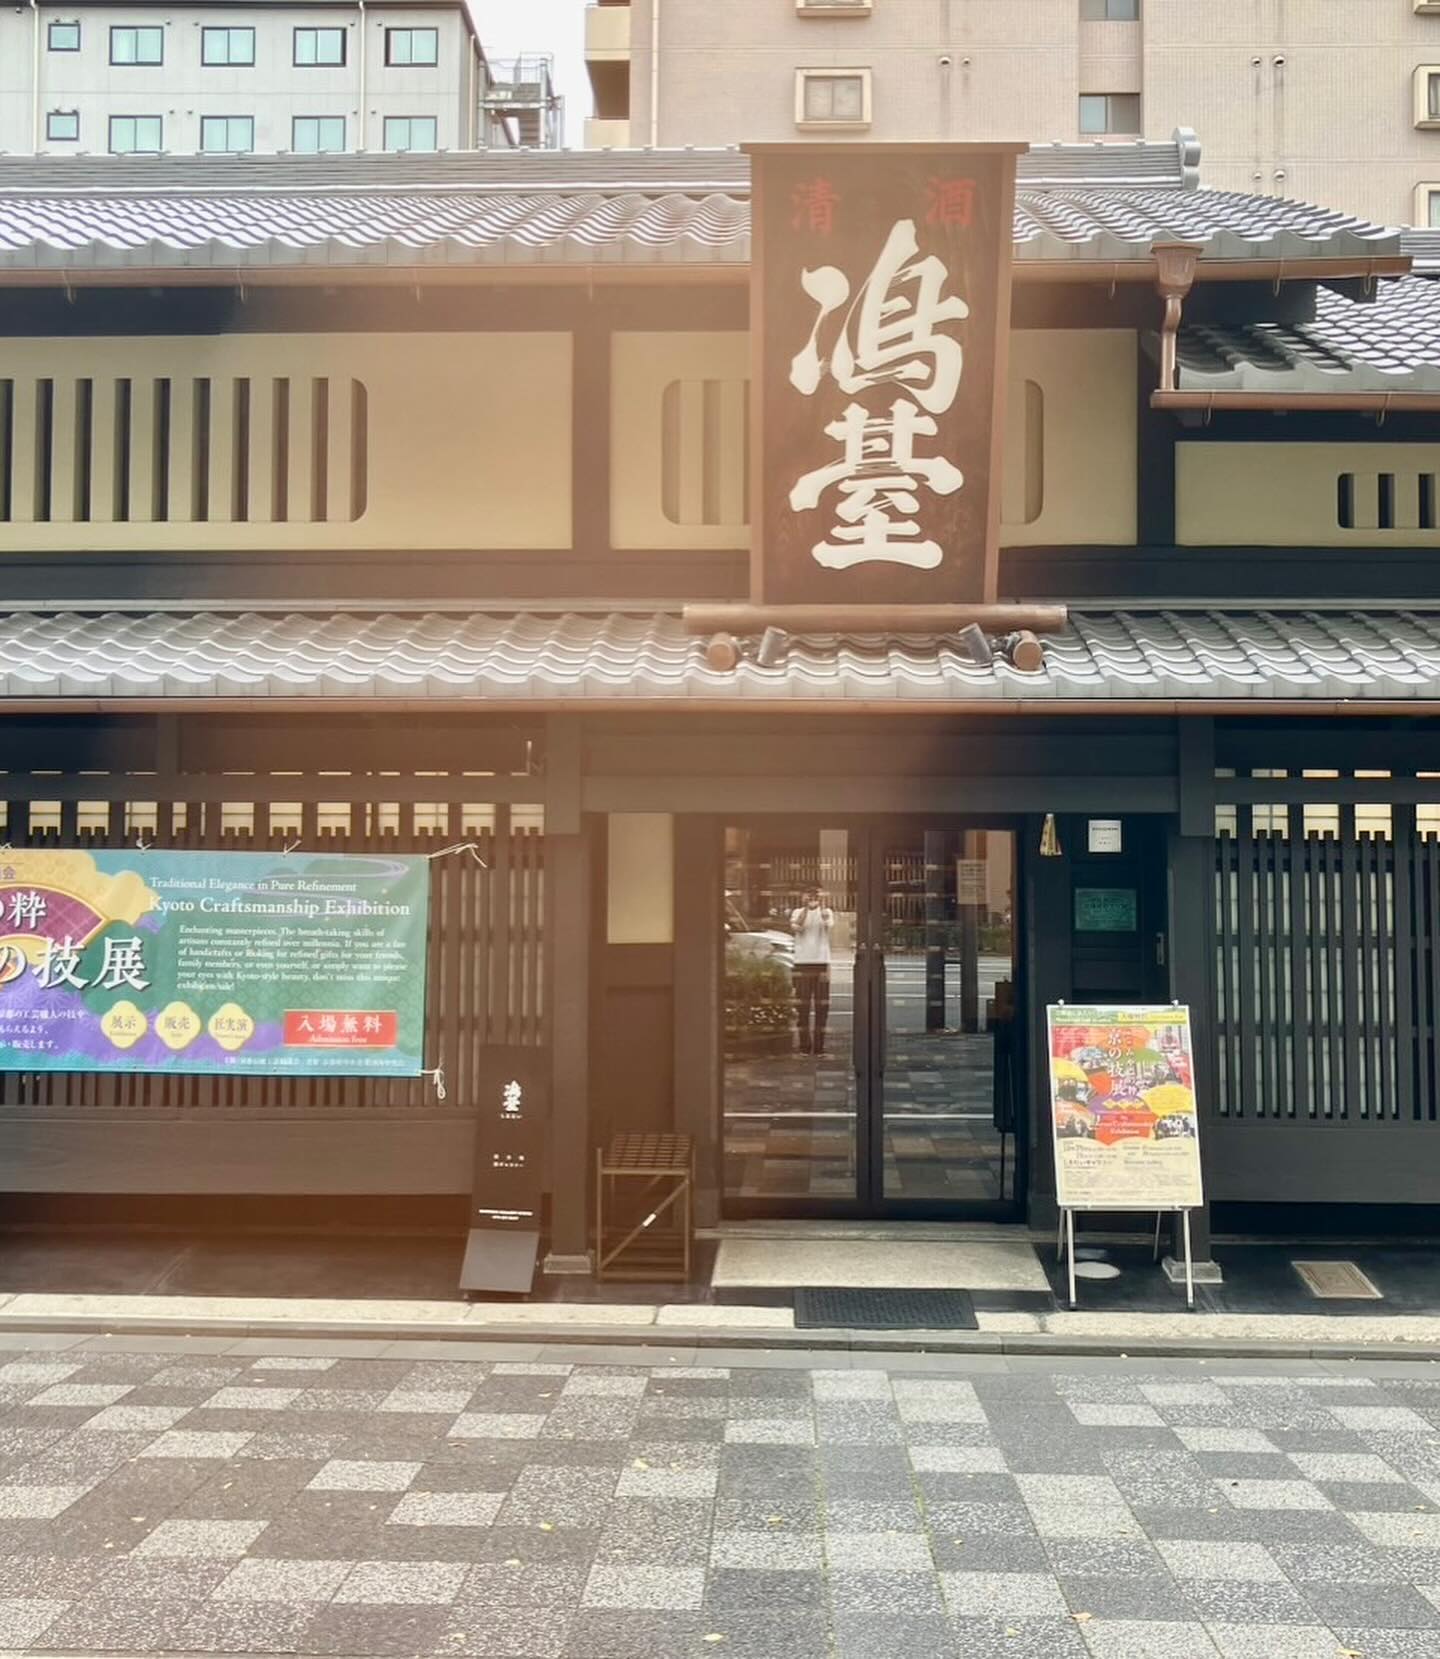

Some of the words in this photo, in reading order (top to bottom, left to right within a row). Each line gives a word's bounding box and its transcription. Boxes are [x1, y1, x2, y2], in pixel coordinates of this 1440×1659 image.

[149, 877, 206, 889] Traditional
[209, 878, 255, 892] Elegance
[257, 880, 268, 889] in
[271, 880, 294, 890] Pure
[297, 880, 357, 892] Refinement
[0, 891, 46, 929] 粋
[149, 897, 195, 917] Kyoto
[200, 897, 320, 918] Craftsmanship
[324, 899, 411, 915] Exhibition
[280, 927, 296, 936] The
[376, 928, 386, 937] of
[178, 948, 187, 956] of
[0, 935, 151, 990] の技展
[177, 959, 202, 968] family
[215, 971, 234, 979] with
[111, 1015, 137, 1030] 展示
[164, 1015, 191, 1030] 販売
[295, 1014, 383, 1034] 入場無料
